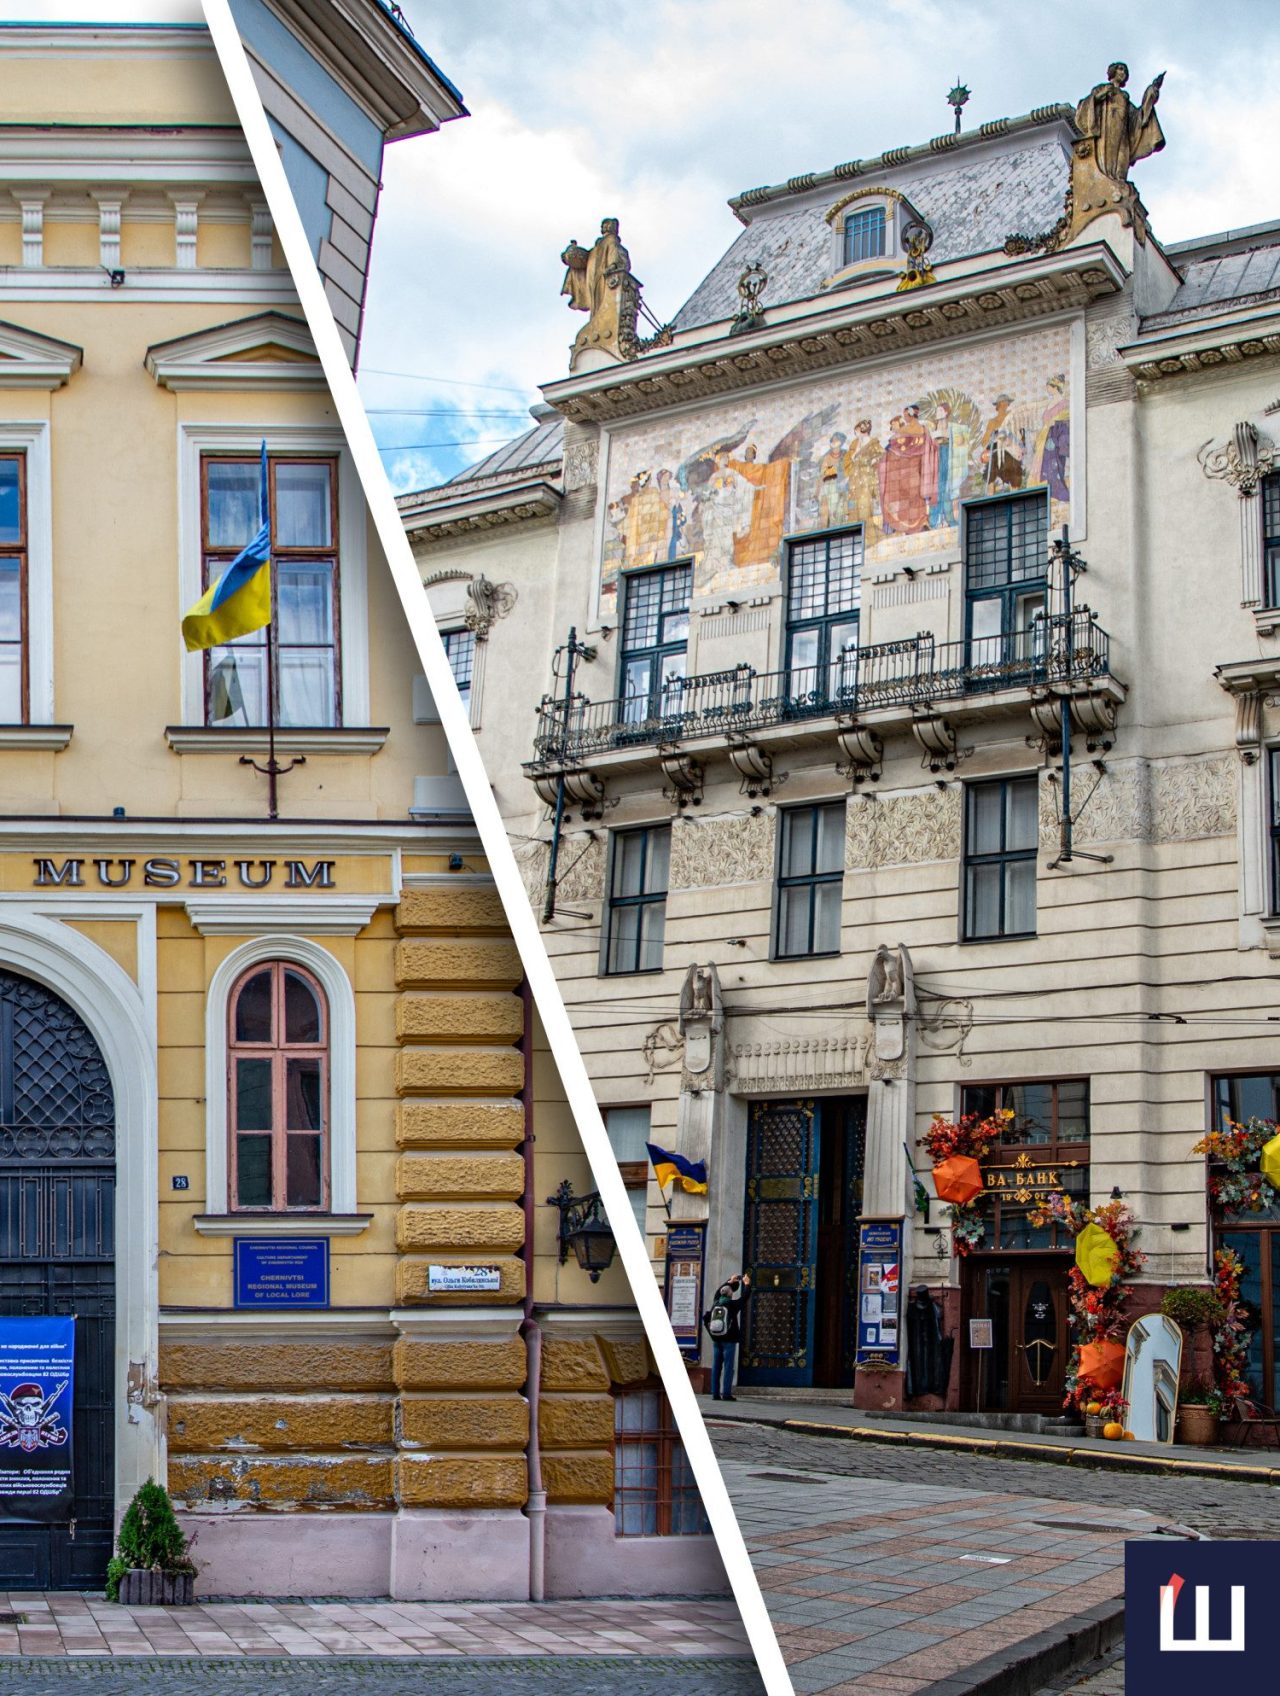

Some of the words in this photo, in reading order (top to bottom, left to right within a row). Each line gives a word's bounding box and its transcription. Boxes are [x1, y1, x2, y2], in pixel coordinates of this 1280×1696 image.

[33, 858, 335, 888] MUSEUM
[175, 1177, 187, 1188] 28
[987, 1171, 1058, 1186] ВА-БАНК
